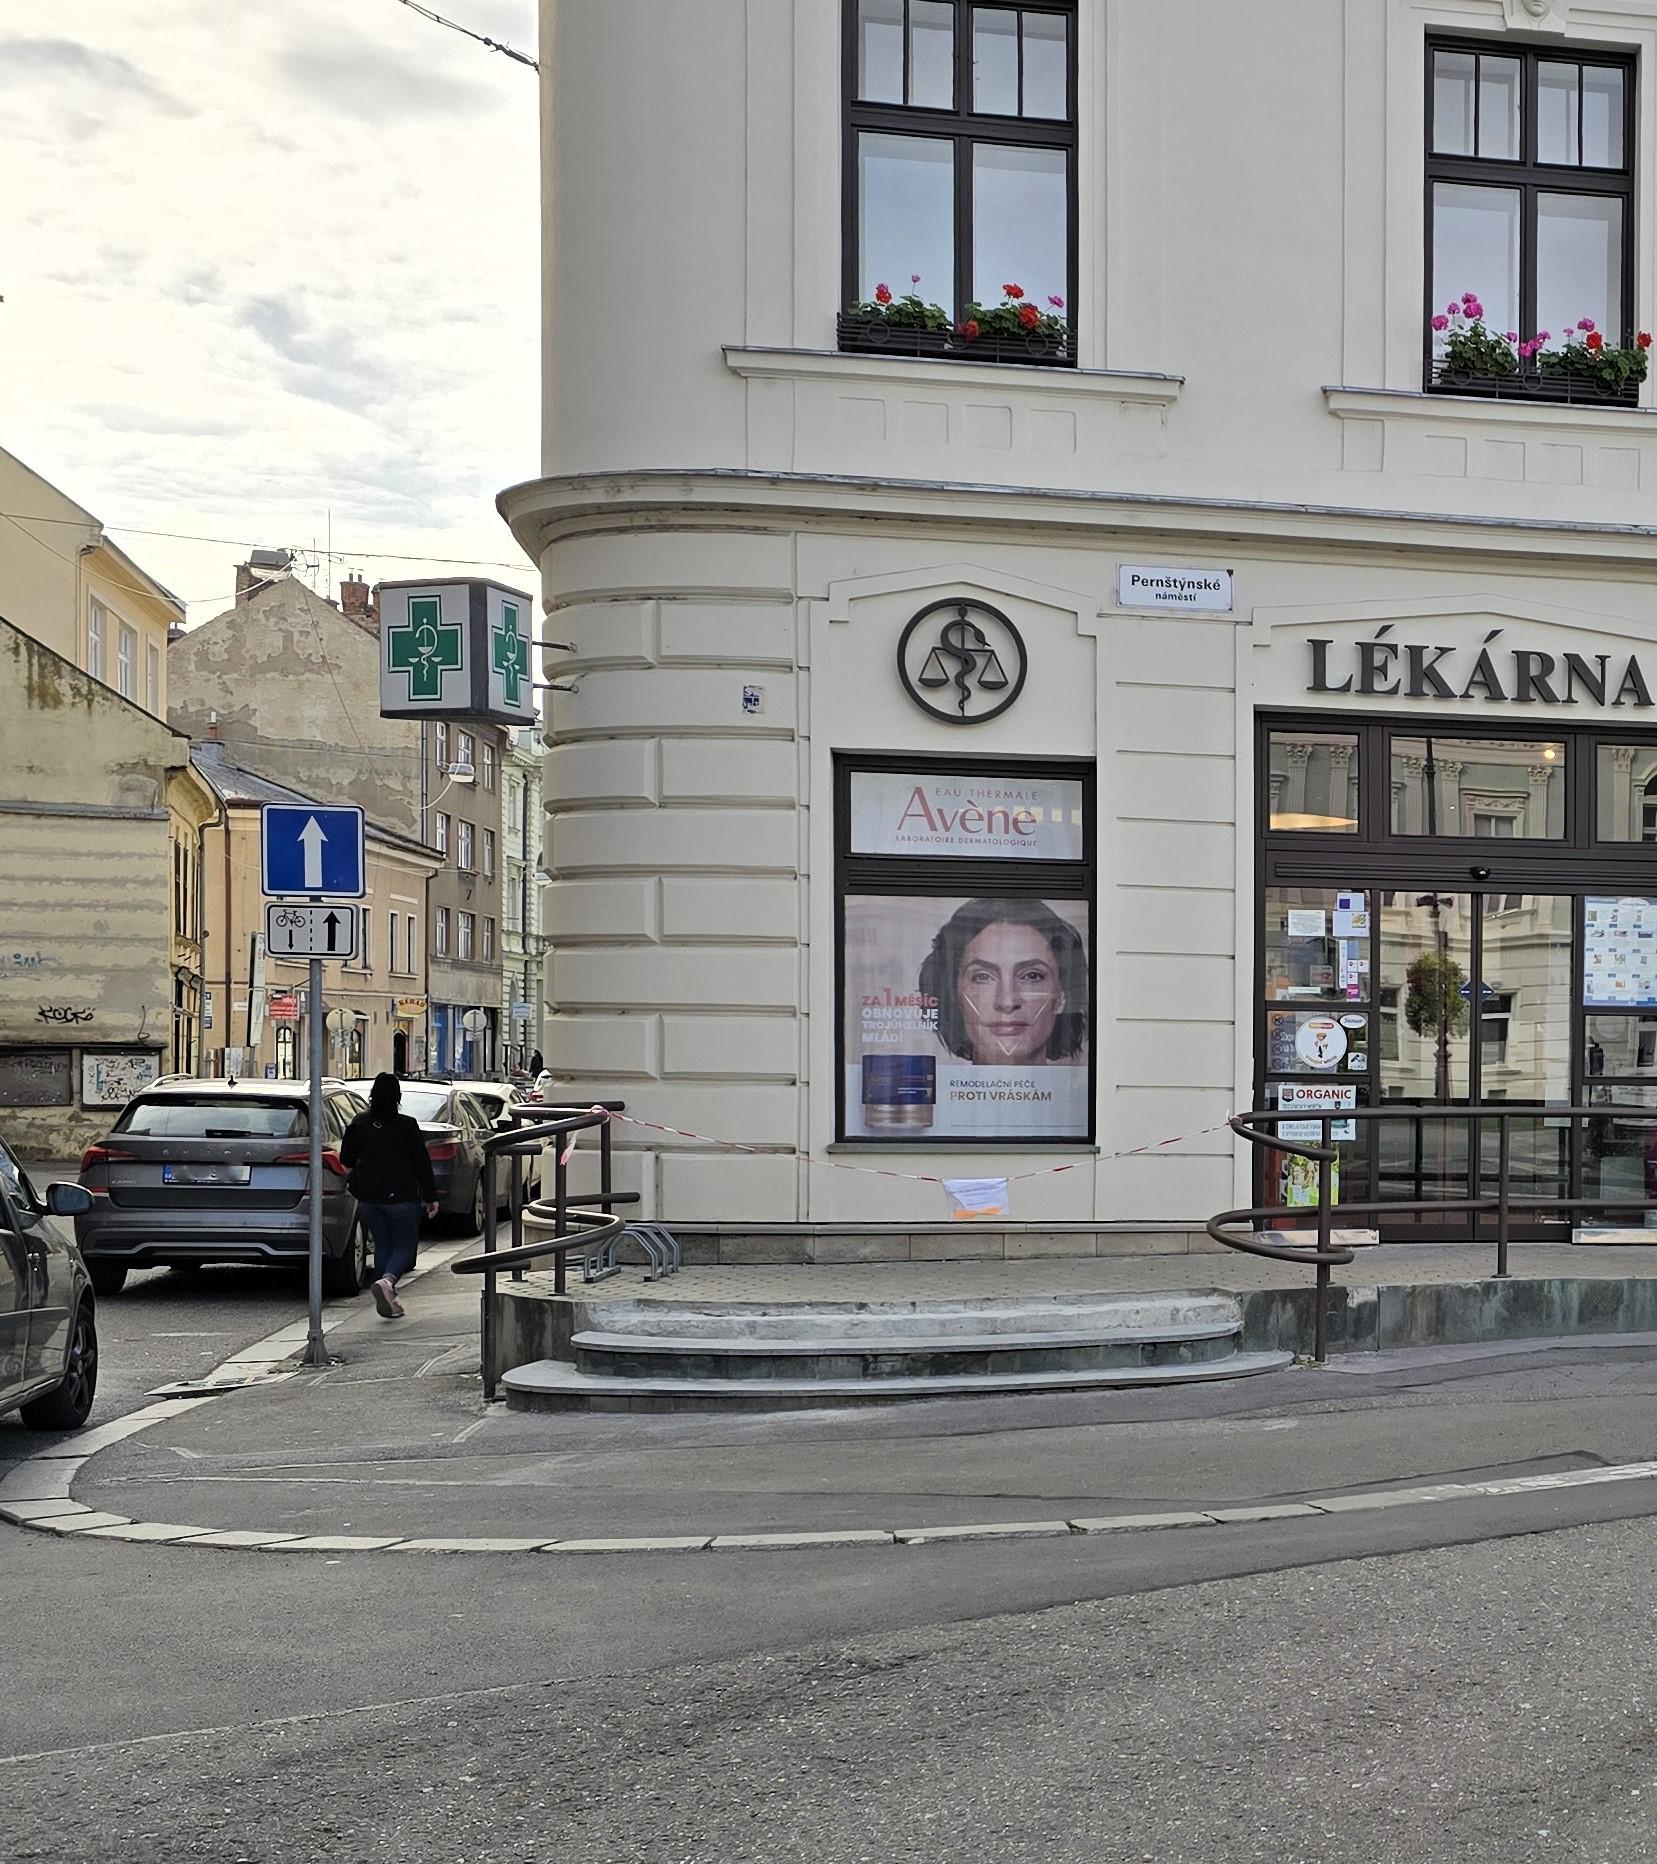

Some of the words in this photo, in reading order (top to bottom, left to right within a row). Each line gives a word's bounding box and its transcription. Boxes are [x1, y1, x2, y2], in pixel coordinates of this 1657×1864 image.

[1131, 574, 1221, 591] Pernštýnské
[1155, 592, 1197, 602] náměstí
[1306, 623, 1656, 707] LÉKÁRNA
[935, 787, 962, 798] EAU
[969, 788, 1038, 801] THERMALE
[896, 786, 1037, 836] Avène
[896, 835, 954, 844] LABORATOIRE
[958, 837, 1038, 847] DERMATOLOGIQUE
[862, 995, 881, 1006] ZA
[883, 987, 892, 1006] 1
[861, 1008, 939, 1019] OBNOVUJE
[861, 1031, 904, 1043] MLÁDÍ
[949, 1079, 1012, 1088] REMODELAČNÍ
[949, 1091, 986, 1101] PROTI
[989, 1089, 1052, 1102] VRÁSKÁM
[1296, 1089, 1352, 1099] ORGANIC
